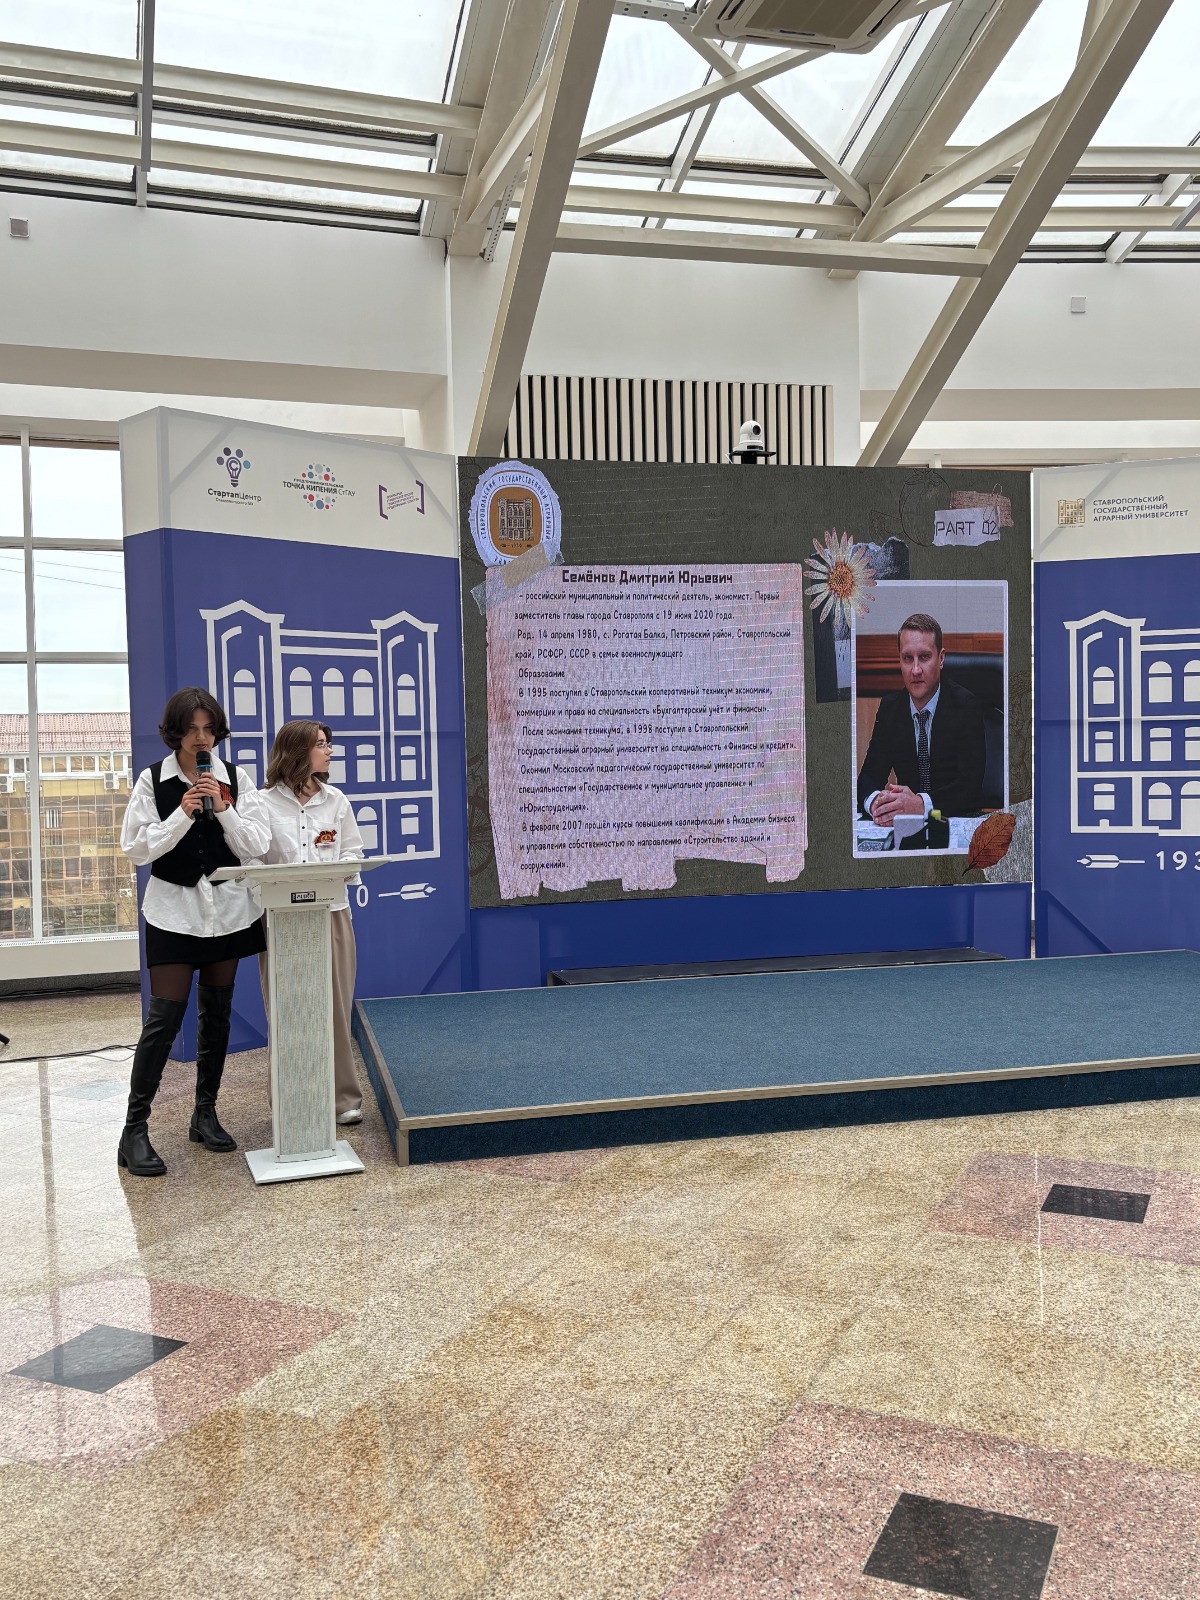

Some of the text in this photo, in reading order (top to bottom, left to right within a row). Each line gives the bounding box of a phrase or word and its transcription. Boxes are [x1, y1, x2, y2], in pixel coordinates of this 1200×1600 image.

[207, 488, 262, 501] СтартапЦентр
[283, 481, 305, 490] ТОЧКА
[306, 484, 337, 494] КИПЕНИЯ
[1093, 495, 1165, 506] СТАВРОПОЛЬСКИЙ
[1093, 503, 1168, 514] ГОСУДАРСТВЕННЫЙ
[1093, 509, 1189, 522] АГРАРНЫЙ УНИВЕРСИТЕТ
[544, 503, 552, 540] АГРАРНЫЙ
[935, 520, 1000, 536] PART 02
[562, 570, 733, 587] Семёнов Дмитрий Юрьевич
[526, 591, 566, 603] российский
[569, 591, 623, 604] муниципальный
[632, 592, 679, 601] политический
[682, 593, 712, 601] деятель,
[755, 591, 779, 603] Первый
[515, 612, 560, 620] заместитель
[587, 613, 611, 623] города
[613, 610, 653, 623] Ставрополя
[663, 610, 672, 619] 19
[694, 610, 714, 619] 2020
[716, 612, 735, 620] года.
[517, 629, 534, 640] Род.
[538, 630, 547, 639] 14
[550, 632, 575, 642] апреля
[577, 629, 600, 640] 1980,
[613, 629, 641, 641] Рогатая
[643, 629, 668, 640] Балка,
[671, 629, 710, 641] Петровский
[713, 630, 734, 641] район,
[737, 629, 791, 640] Ставропольский
[515, 649, 535, 662] край,
[537, 649, 567, 659] РСФСР,
[570, 648, 590, 658] СССР
[621, 651, 683, 661] военнослужащего
[519, 668, 565, 681] Образование
[519, 688, 524, 697] В
[527, 688, 547, 697] 1995
[550, 689, 582, 700] поступил
[591, 687, 646, 699] Ставропольский
[649, 686, 700, 698] кооперативный
[702, 687, 733, 697] техникум
[735, 687, 773, 695] экономики,
[517, 709, 556, 720] коммерции
[565, 709, 585, 719] права
[598, 707, 650, 719] специальность
[652, 704, 706, 717] «Бухгалтерский
[709, 705, 724, 716] учёт
[733, 704, 769, 716] финансы».
[523, 726, 543, 736] После
[546, 727, 582, 735] окончания
[585, 727, 624, 737] техникума,
[634, 724, 652, 733] 1998
[655, 725, 686, 736] поступил
[688, 725, 692, 733] в
[694, 723, 748, 736] Ставропольский
[518, 745, 579, 758] государственный
[582, 744, 614, 757] аграрный
[617, 744, 658, 755] университет
[672, 744, 721, 754] специальность
[724, 742, 757, 751] «Финансы
[766, 742, 796, 752] кредит».
[521, 765, 550, 775] Окончил
[553, 764, 594, 773] Московский
[597, 763, 651, 773] педагогический
[654, 761, 712, 773] государственный
[714, 761, 754, 772] университет
[519, 785, 576, 796] специальностям
[579, 782, 642, 795] «Государственное
[652, 782, 702, 793] муниципальное
[705, 781, 746, 792] управление»
[520, 802, 589, 815] «Юриспруденция».
[522, 823, 527, 832] В
[530, 822, 559, 836] феврале
[562, 821, 582, 830] 2007
[585, 821, 610, 832] прошёл
[613, 821, 632, 832] курсы
[635, 820, 672, 828] повышения
[675, 817, 724, 829] квалификации
[732, 815, 765, 826] Академии
[769, 814, 795, 823] бизнеса
[526, 842, 566, 854] управления
[568, 839, 625, 849] собственностью
[638, 837, 681, 850] направлению
[684, 835, 738, 846] «Строительство
[740, 833, 765, 844] зданий
[521, 859, 568, 873] сооружений».
